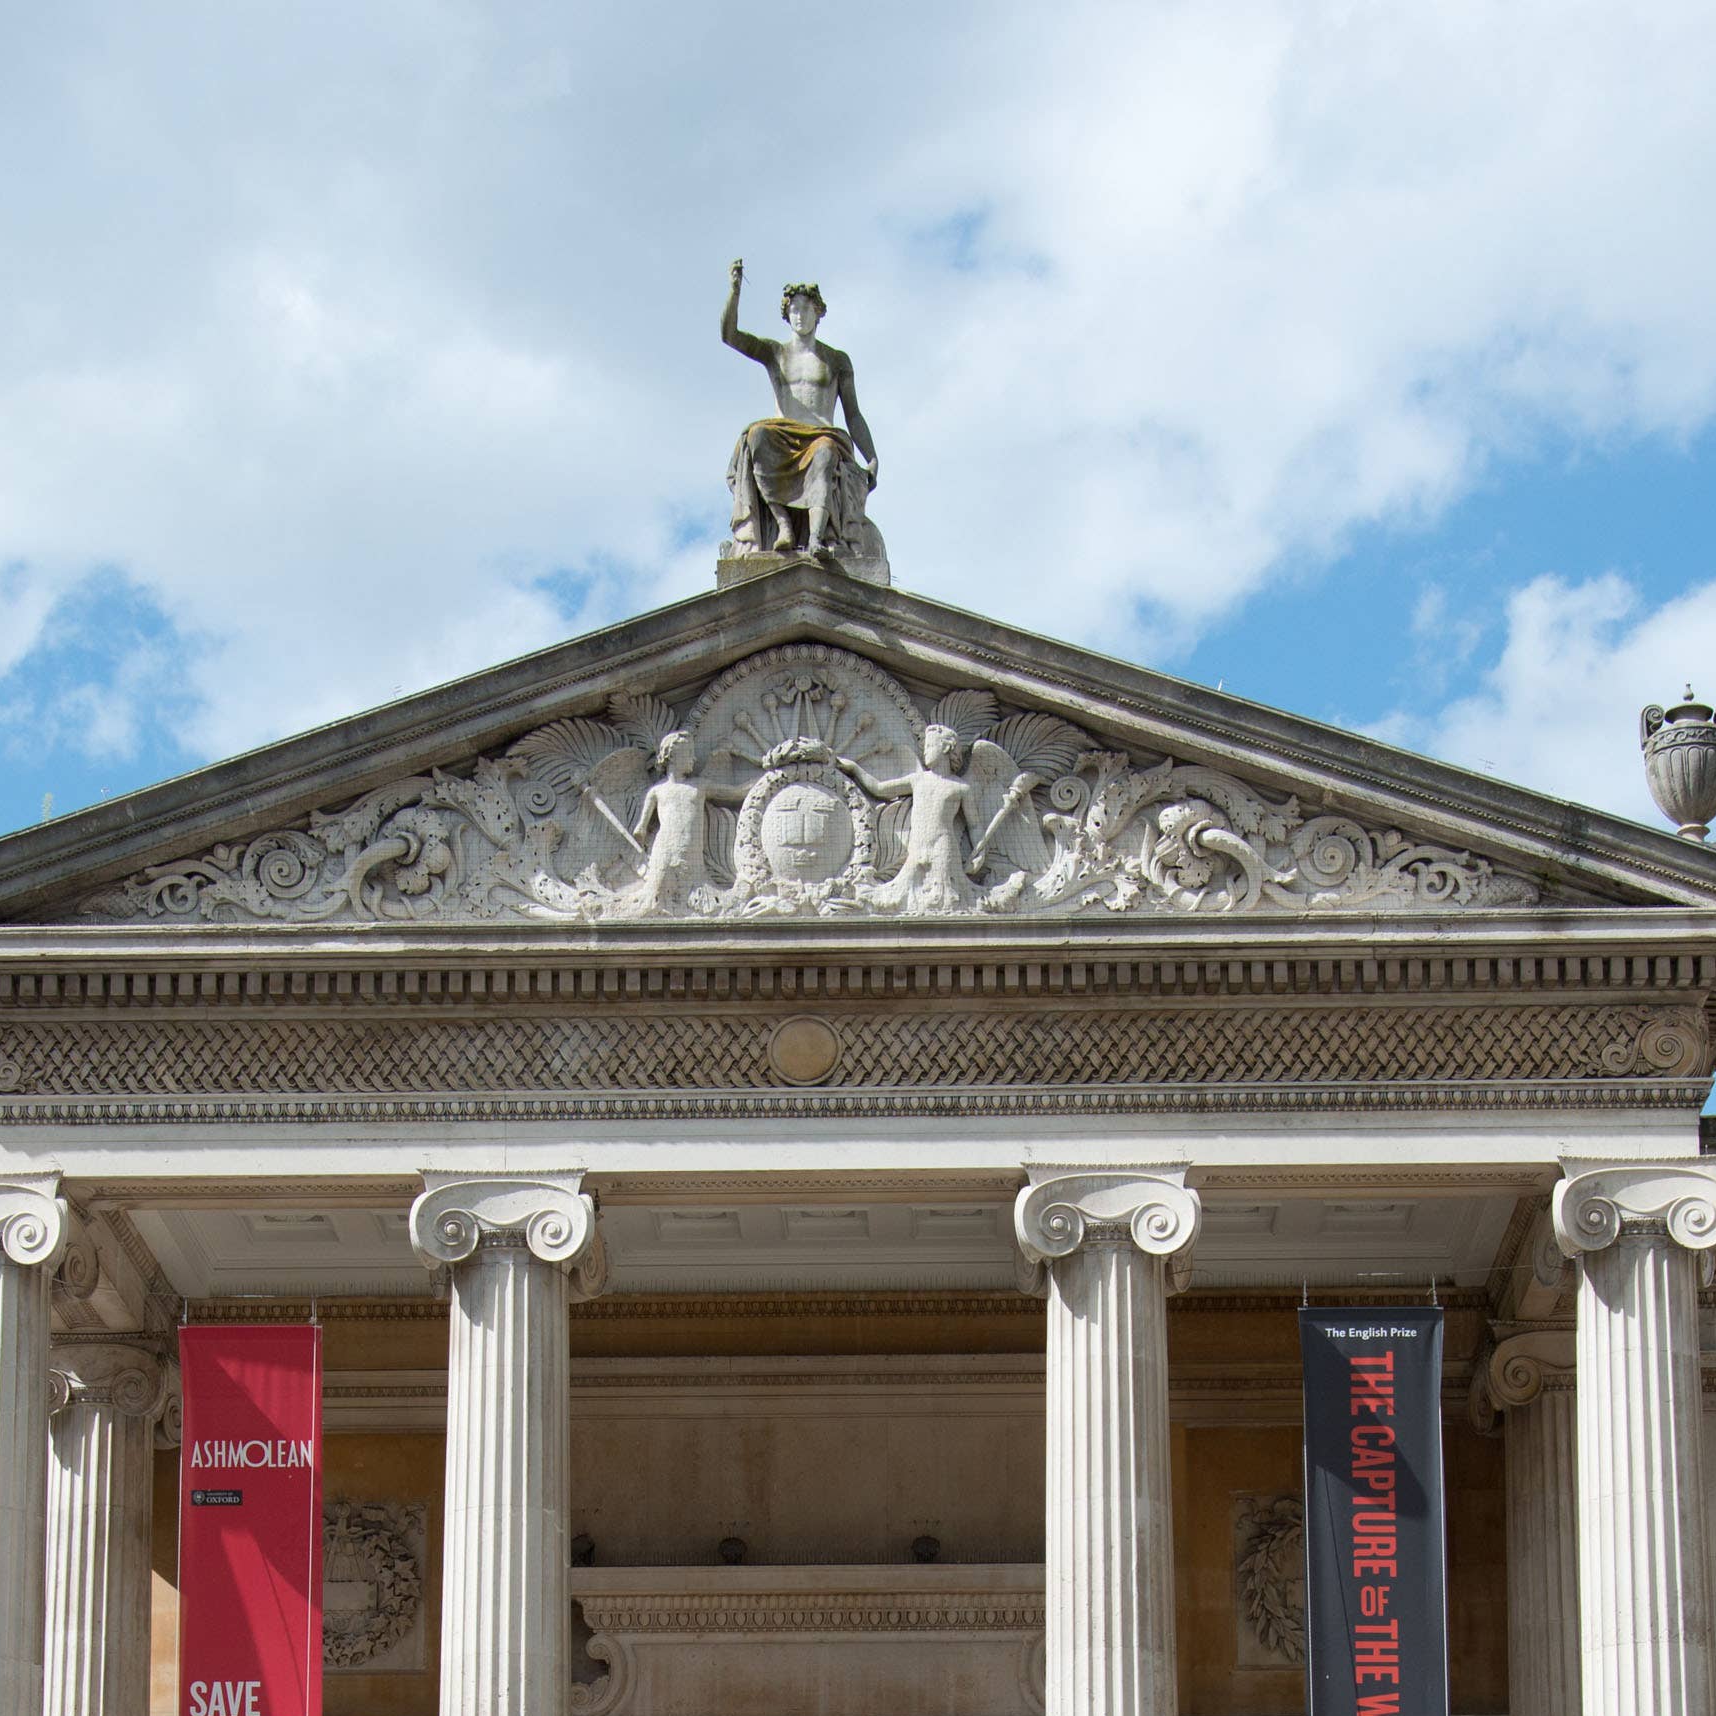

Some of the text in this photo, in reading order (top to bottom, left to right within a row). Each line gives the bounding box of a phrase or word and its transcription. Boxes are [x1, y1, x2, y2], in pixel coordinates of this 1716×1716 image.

[1325, 1327, 1417, 1340] The English Prize
[1350, 1351, 1394, 1416] THE
[191, 1440, 312, 1468] ASHMOLEAN
[206, 1496, 240, 1504] OXFORD
[1351, 1426, 1397, 1578] CAPTURE
[1361, 1586, 1391, 1616] OF
[1354, 1619, 1400, 1685] THE
